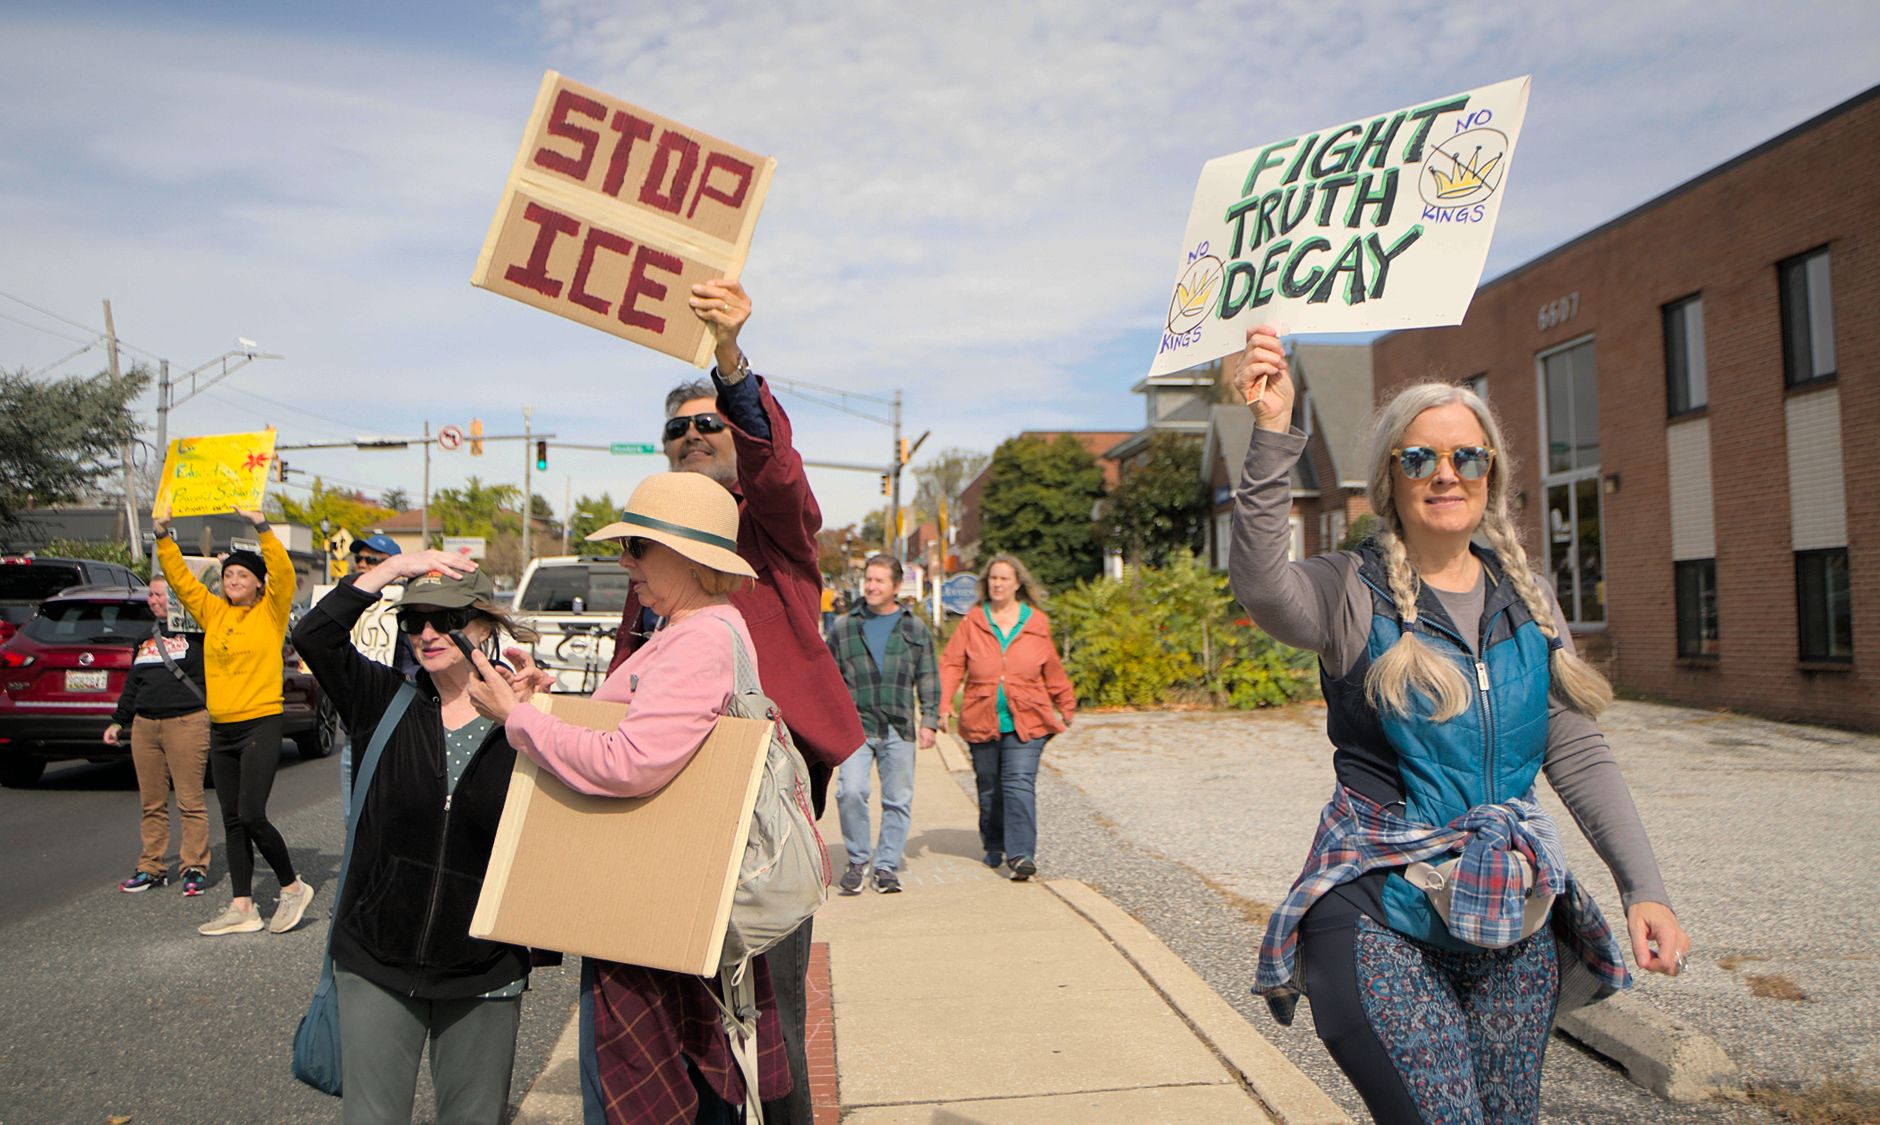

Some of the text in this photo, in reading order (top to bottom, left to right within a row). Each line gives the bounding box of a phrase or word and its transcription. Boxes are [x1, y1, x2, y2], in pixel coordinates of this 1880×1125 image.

[533, 88, 754, 219] STOP
[1241, 94, 1471, 198] FIGHT
[1455, 108, 1492, 133] NO
[1187, 240, 1209, 265] NO
[1224, 167, 1399, 260] TRUTH
[1421, 204, 1486, 224] KINGS
[503, 201, 684, 334] ICE
[1215, 224, 1425, 320] DECAY
[1159, 326, 1203, 354] KINGS
